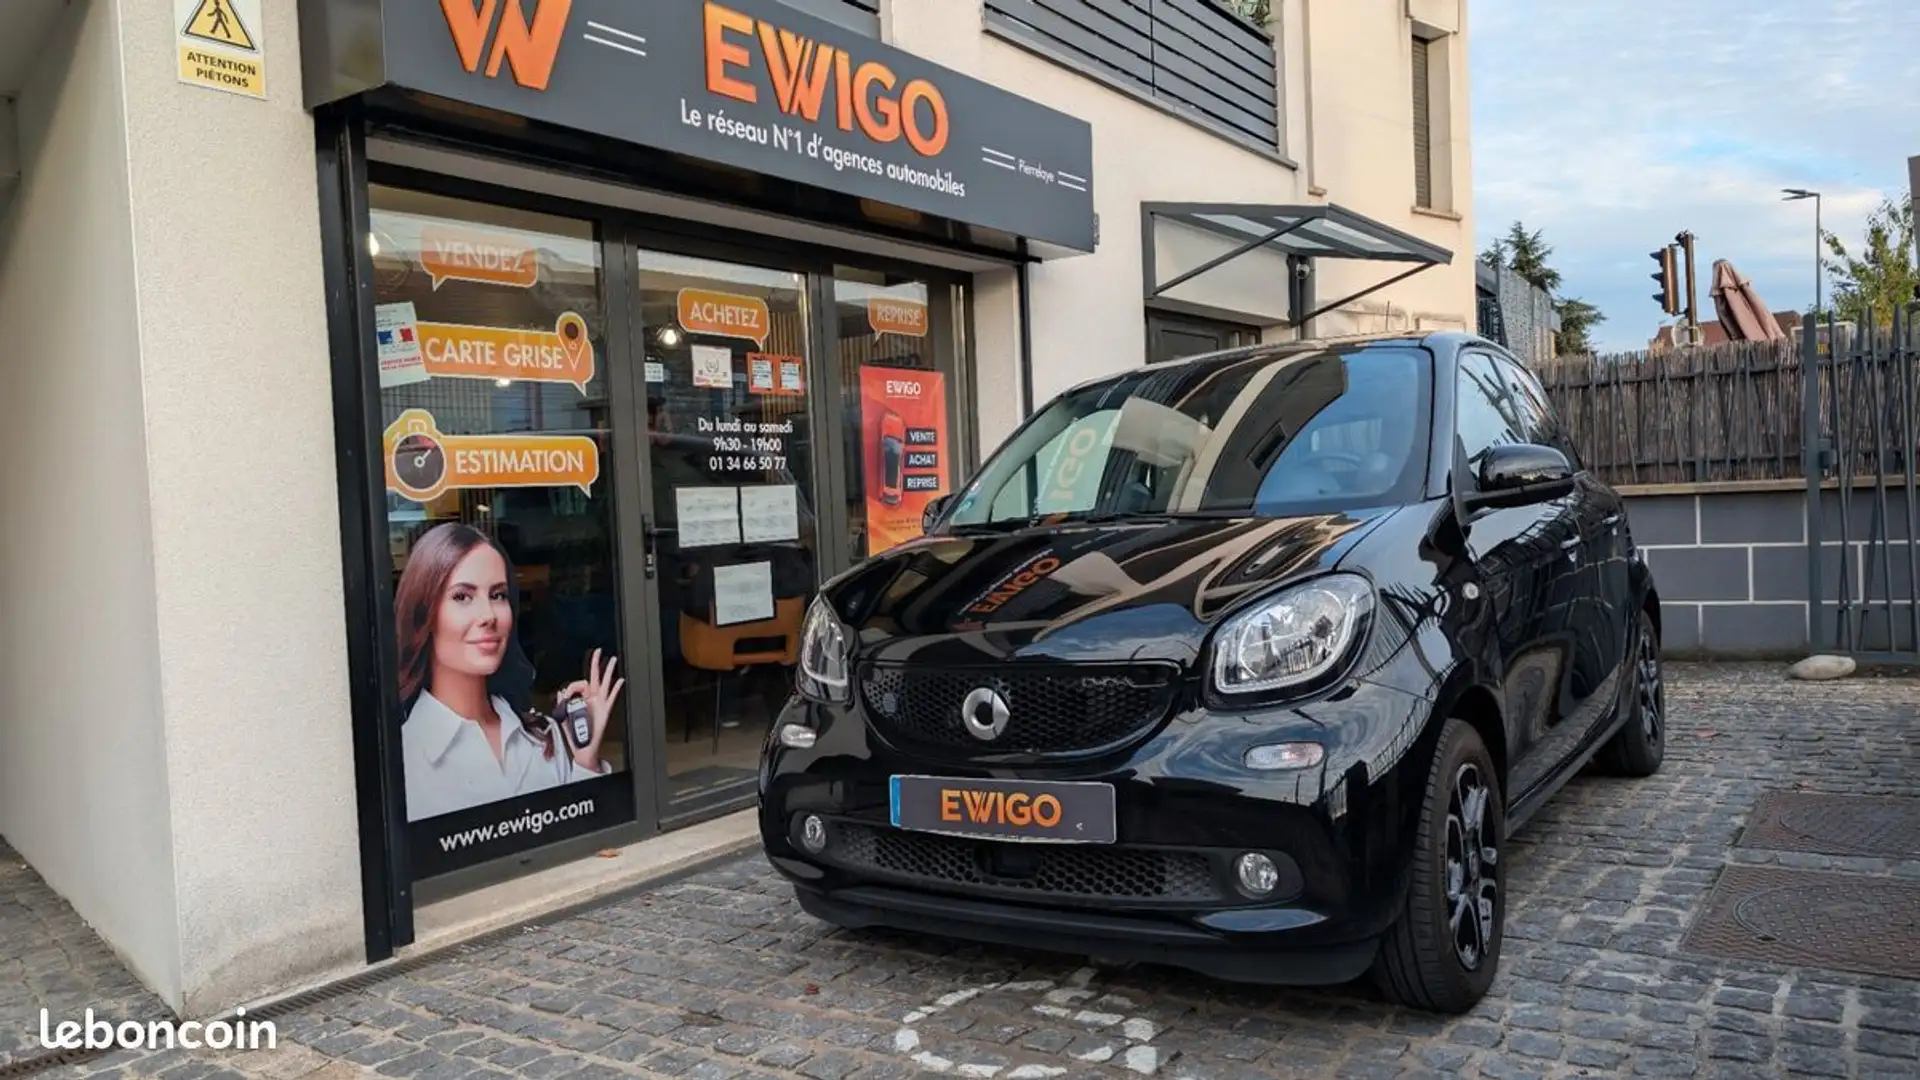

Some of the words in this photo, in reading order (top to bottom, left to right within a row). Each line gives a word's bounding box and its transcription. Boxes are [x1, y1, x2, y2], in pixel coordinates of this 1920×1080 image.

[186, 51, 256, 76] ATTENTION
[195, 67, 249, 88] PIÉTONS
[702, 2, 950, 158] EWIGO
[680, 98, 702, 126] Le
[707, 109, 768, 145] réseau
[887, 164, 966, 197] automobiles
[435, 240, 526, 274] VENDEZ
[689, 301, 760, 329] ACHETEZ
[875, 305, 922, 327] REPRISE
[424, 337, 498, 366] CARTE
[503, 343, 564, 369] GRISE
[885, 379, 922, 396] EWIGO
[697, 417, 714, 432] Du
[715, 416, 742, 433] lundi
[743, 421, 757, 433] au
[758, 419, 794, 434] samedi
[713, 436, 741, 452] 9h30
[750, 437, 782, 452] 19h00
[909, 430, 936, 444] VENTE
[455, 449, 584, 475] ESTIMATION
[709, 456, 723, 471] 01
[726, 456, 741, 471] 34
[743, 456, 757, 471] 66
[758, 456, 773, 471] 50
[774, 456, 787, 471] 77
[908, 451, 936, 466] ACHAT
[906, 475, 938, 489] REPRISE
[941, 788, 1063, 828] EWIGO
[439, 798, 595, 852] www.ewigo.com
